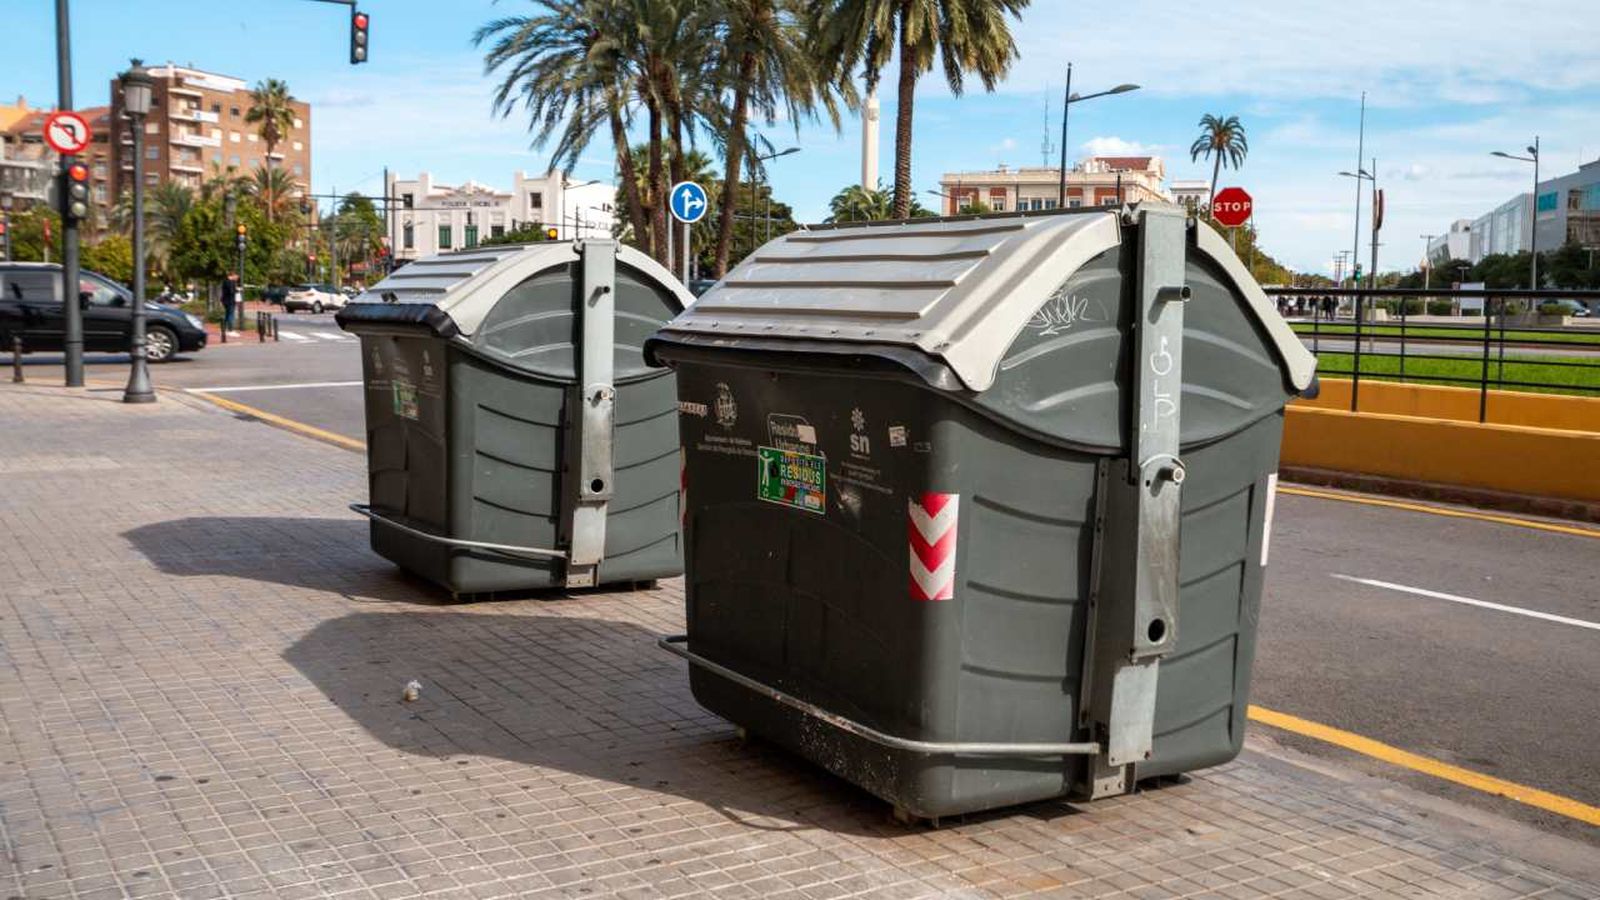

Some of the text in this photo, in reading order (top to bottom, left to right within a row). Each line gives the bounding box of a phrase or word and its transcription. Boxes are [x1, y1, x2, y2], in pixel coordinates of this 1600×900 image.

[1214, 201, 1251, 212] STOP
[849, 433, 870, 455] sn
[780, 463, 821, 485] RESIDUS
